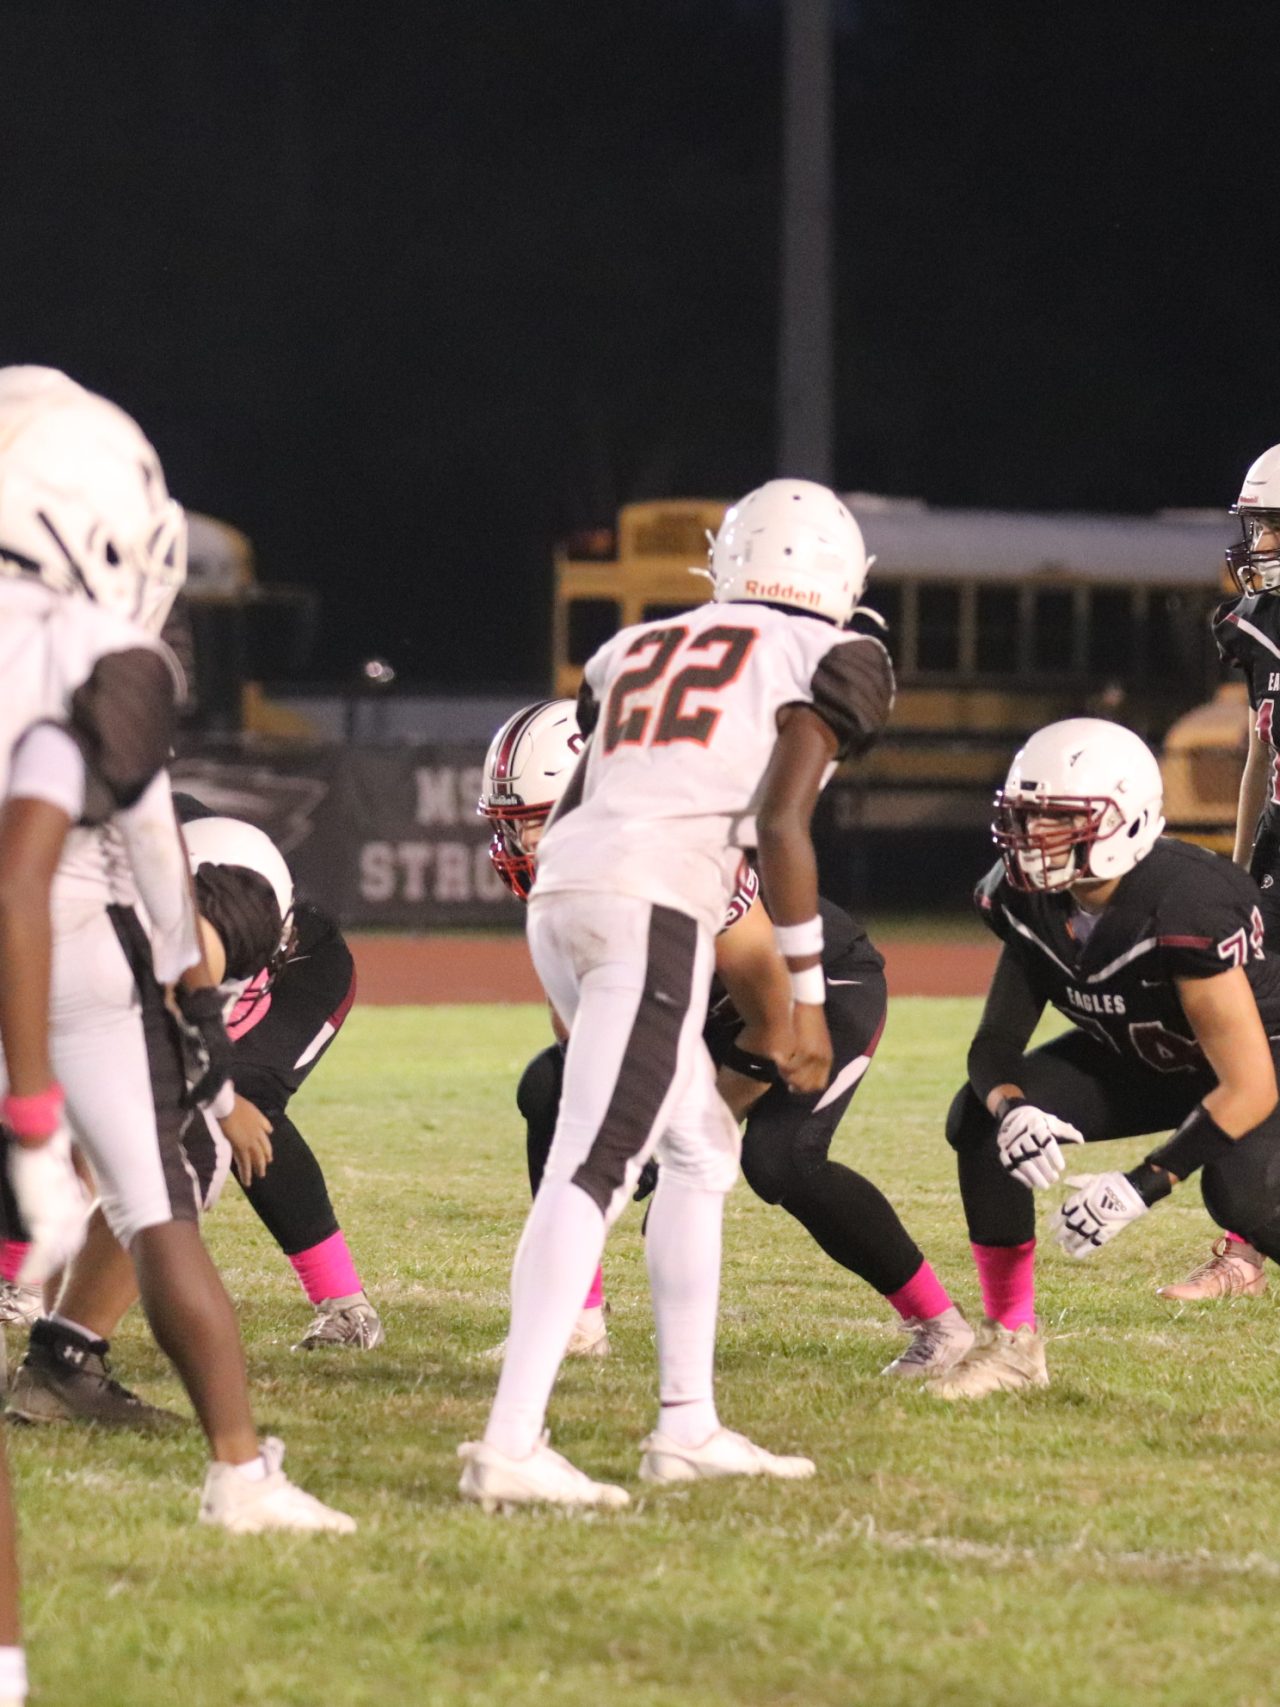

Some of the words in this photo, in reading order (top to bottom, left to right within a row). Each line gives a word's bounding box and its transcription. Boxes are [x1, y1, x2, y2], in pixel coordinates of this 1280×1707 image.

[745, 580, 822, 606] Riddell
[602, 624, 760, 757] 22
[1065, 986, 1127, 1015] EAGLES
